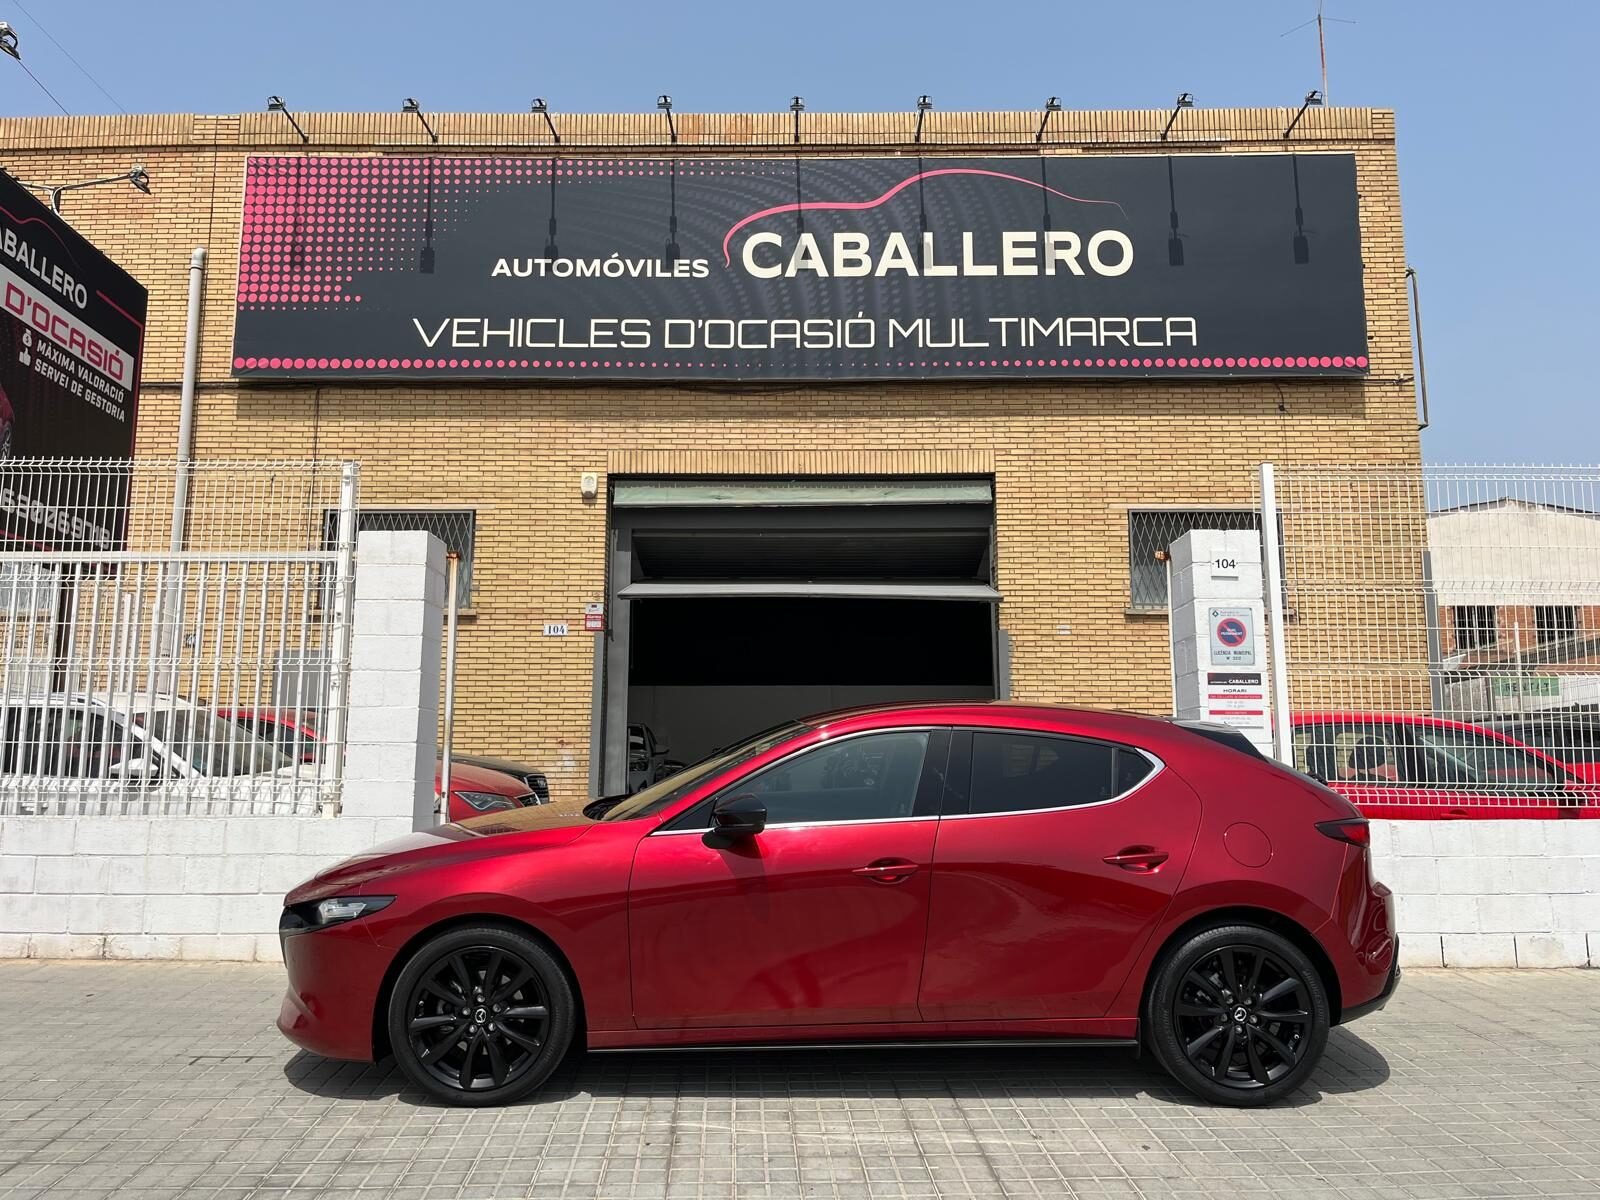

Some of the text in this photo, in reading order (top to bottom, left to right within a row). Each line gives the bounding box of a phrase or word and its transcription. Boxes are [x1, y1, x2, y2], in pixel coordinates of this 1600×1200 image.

[0, 226, 87, 309] BALLERO
[491, 230, 1134, 278] AUTOMÓVILES CABALLERO
[5, 281, 124, 381] D'OCASIÓ
[413, 312, 1197, 349] VEHICLES D'OCASIÓ MULTIMARCA
[34, 358, 125, 423] SERVEI DE GESTORIA
[37, 339, 124, 403] MÀXIMA VALORACIÓ
[1214, 558, 1236, 569] 104
[548, 625, 565, 634] 104
